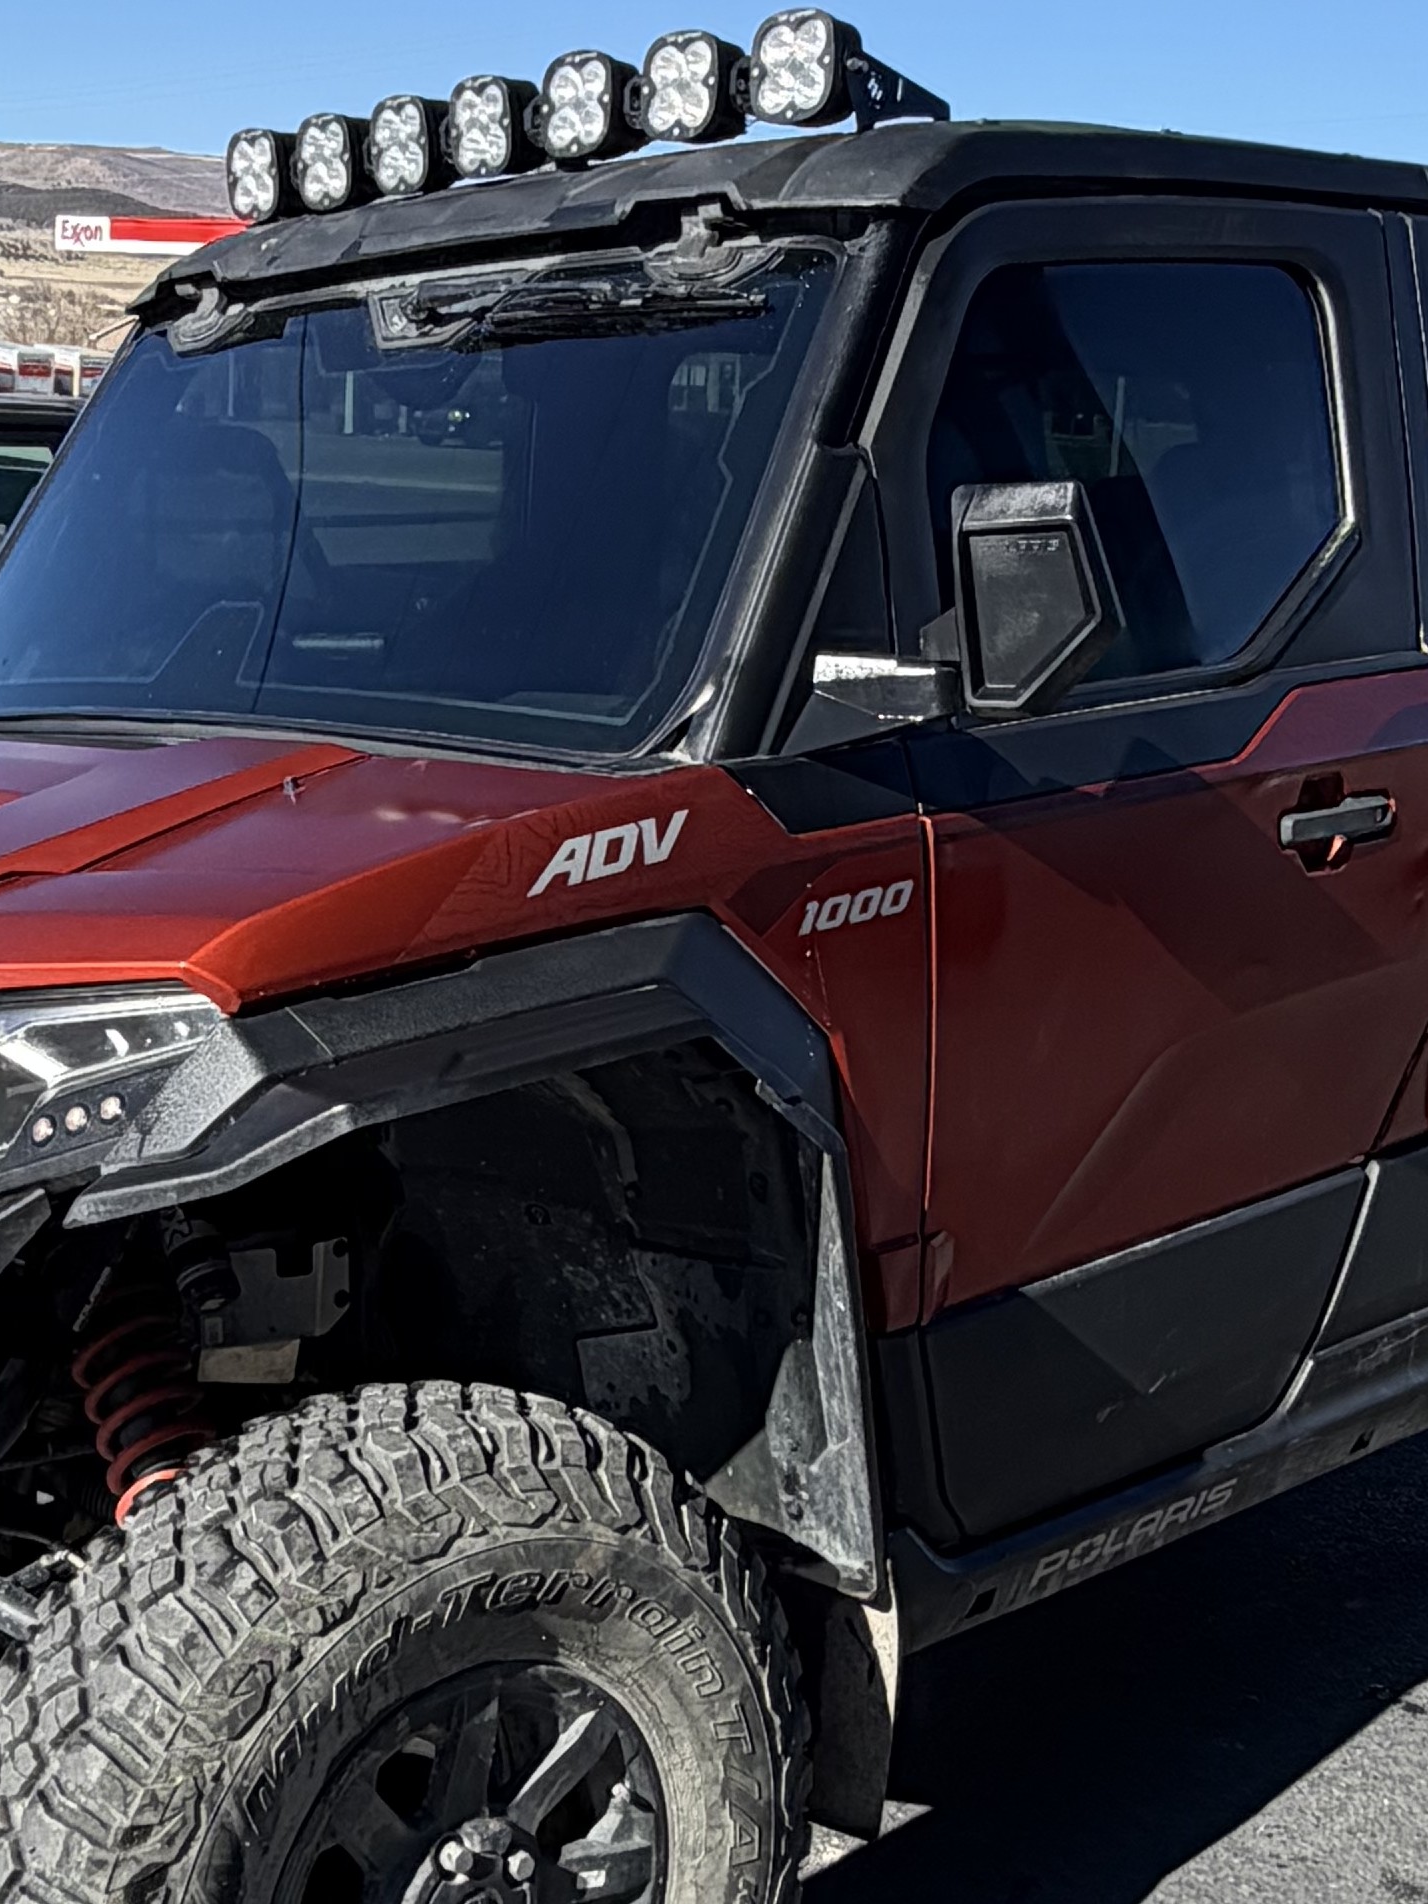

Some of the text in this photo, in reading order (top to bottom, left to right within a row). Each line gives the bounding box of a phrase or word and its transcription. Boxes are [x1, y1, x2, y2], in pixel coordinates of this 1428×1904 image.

[61, 219, 104, 247] Exxon
[527, 809, 690, 898] ADV
[798, 879, 914, 937] 1000
[1027, 1477, 1239, 1595] POLARIS
